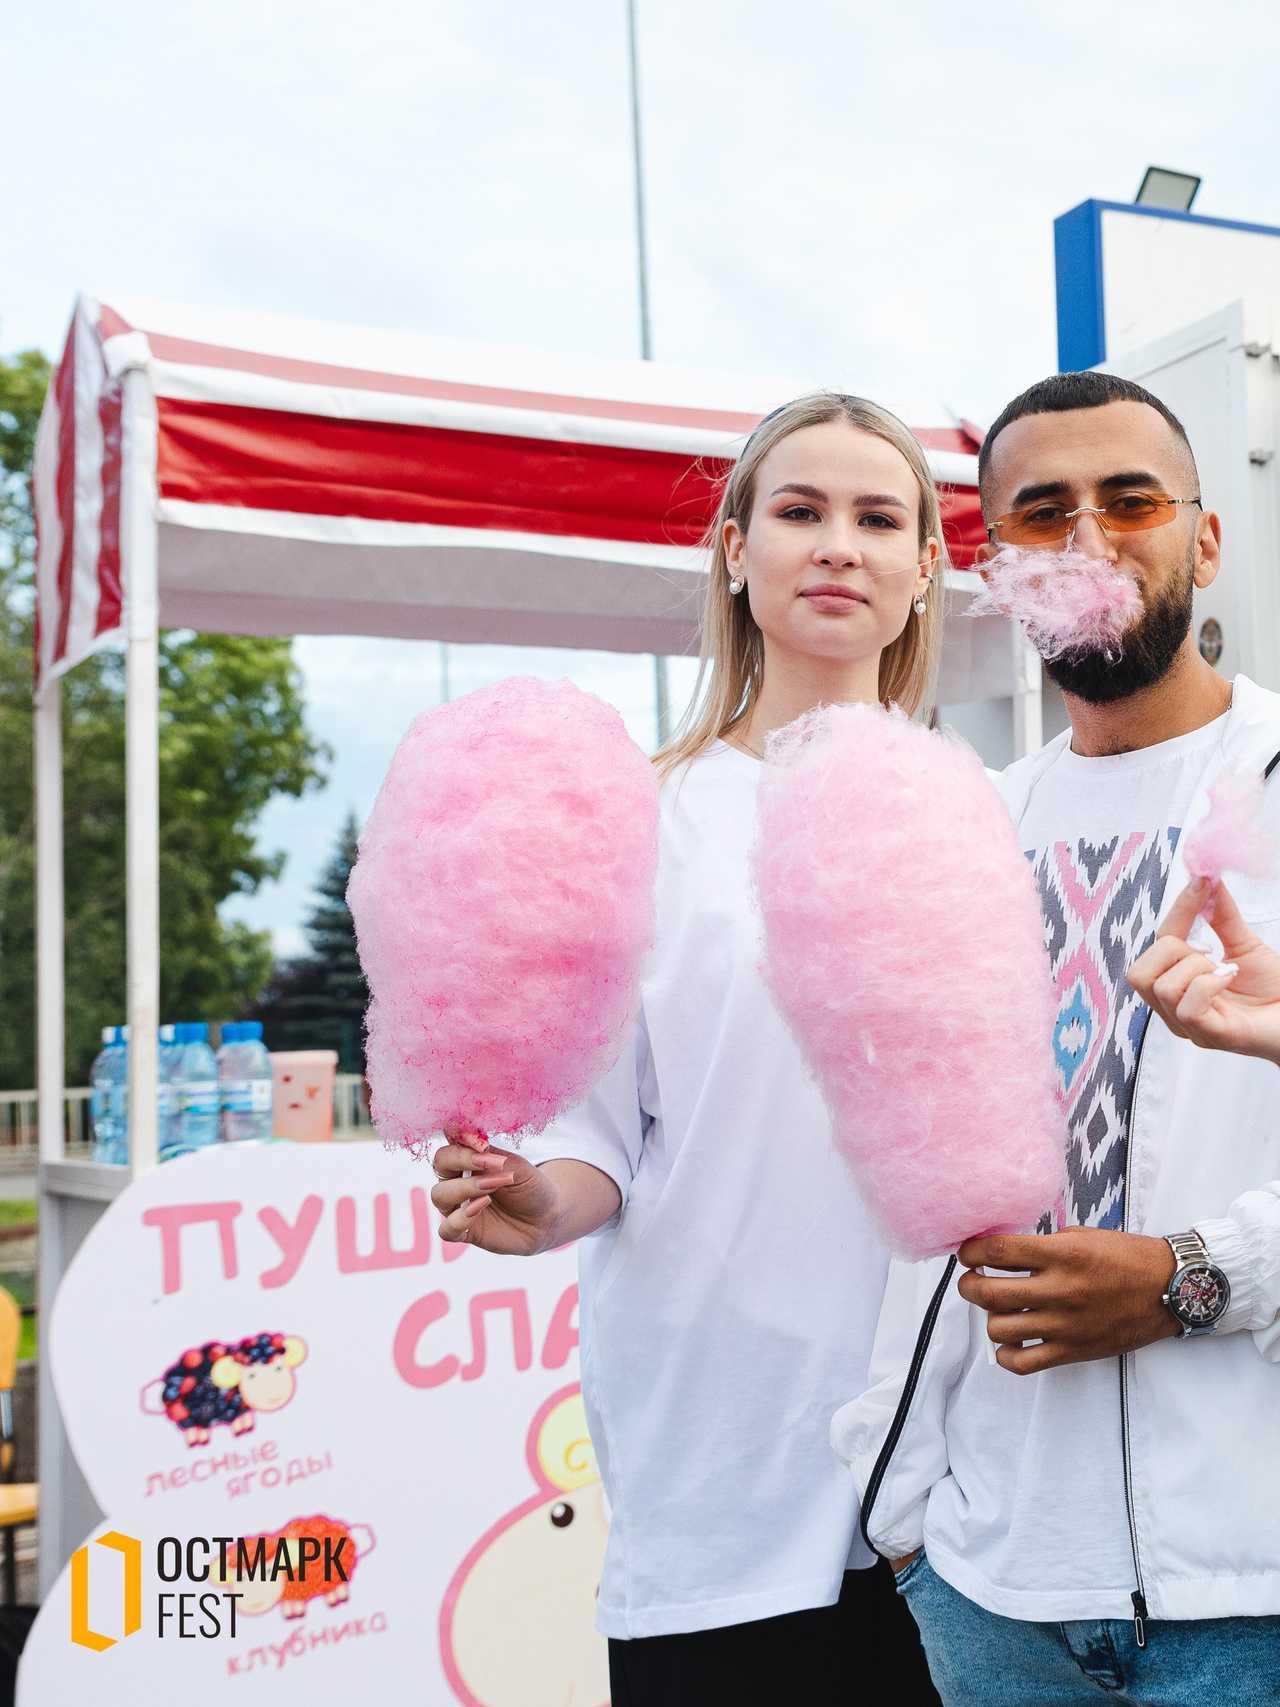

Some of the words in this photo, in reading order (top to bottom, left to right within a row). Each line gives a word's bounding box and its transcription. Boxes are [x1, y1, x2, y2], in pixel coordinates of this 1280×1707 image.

[145, 1440, 279, 1498] лесные
[225, 1451, 334, 1499] ягоды
[226, 1610, 388, 1676] клубника
